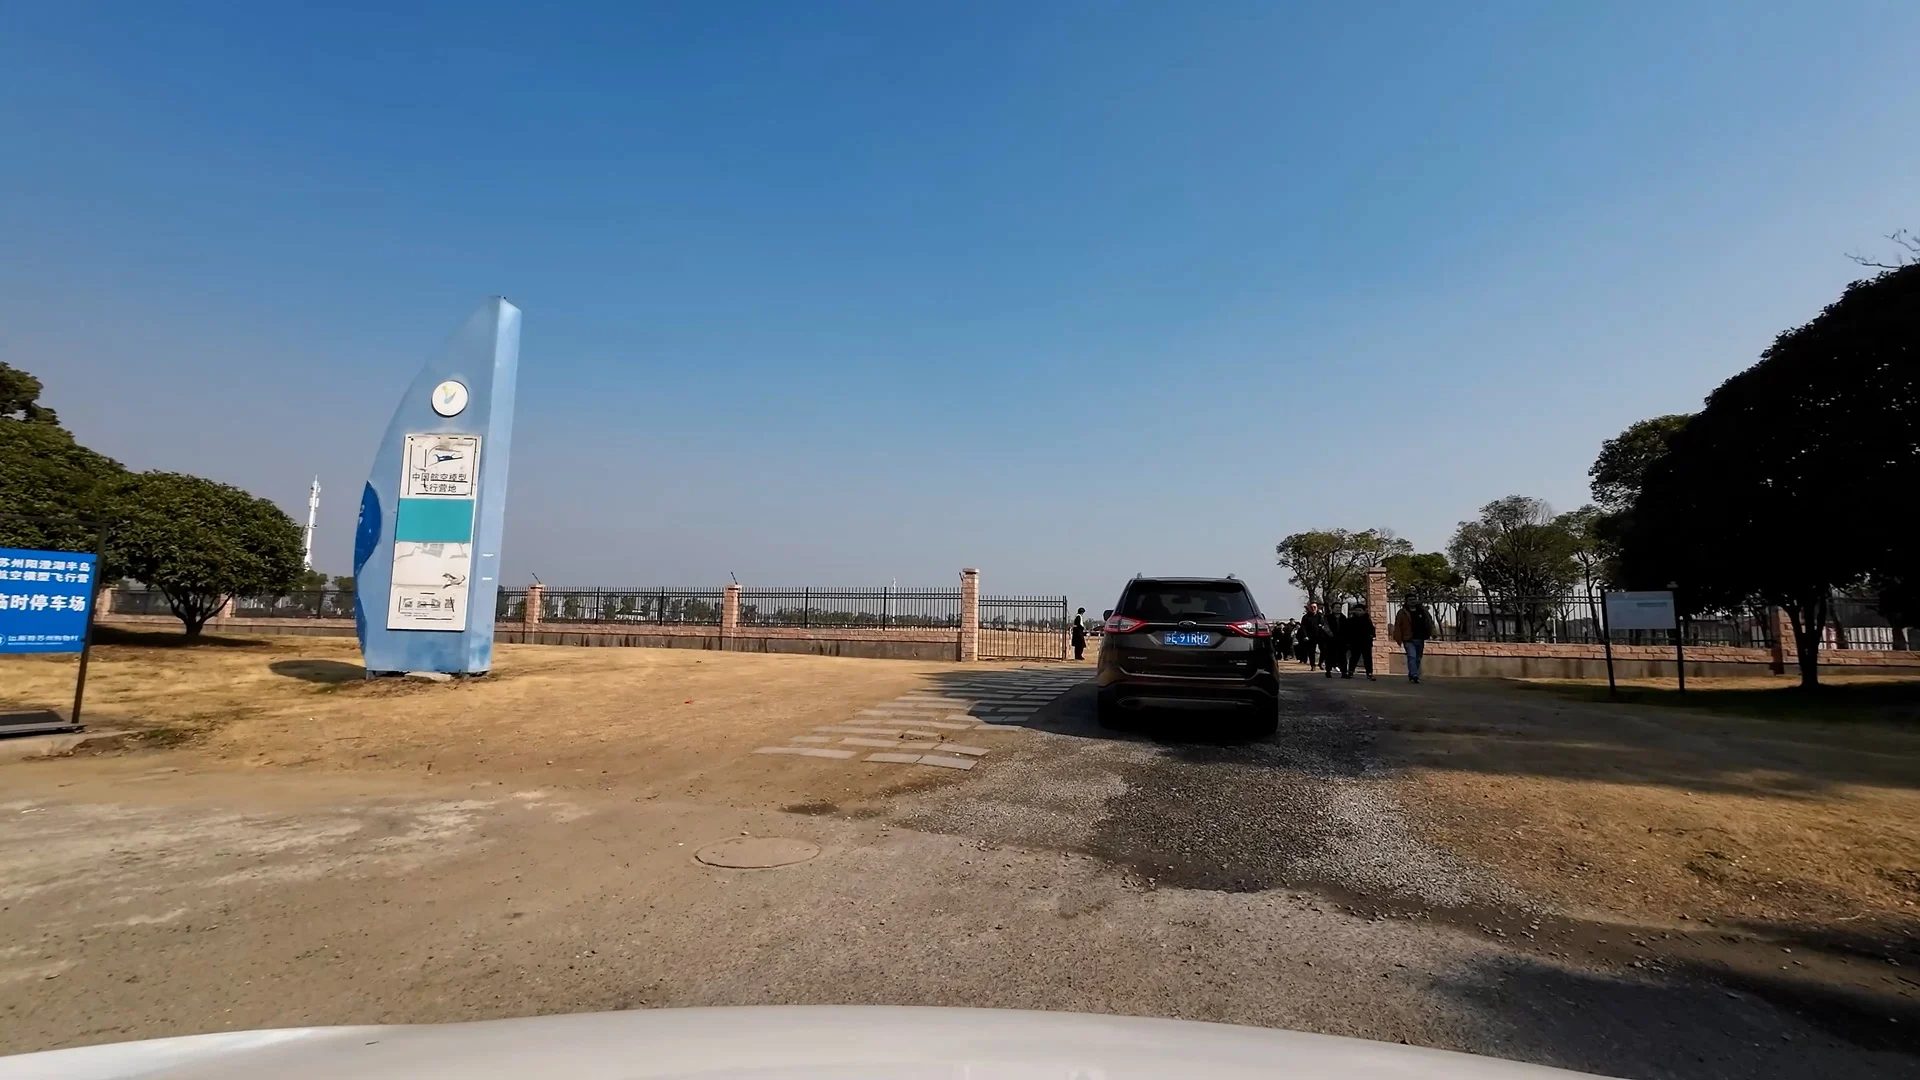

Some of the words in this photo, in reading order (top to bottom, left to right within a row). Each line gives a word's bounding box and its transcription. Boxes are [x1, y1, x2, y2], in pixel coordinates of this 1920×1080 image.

[412, 473, 467, 482] 中国航空模型
